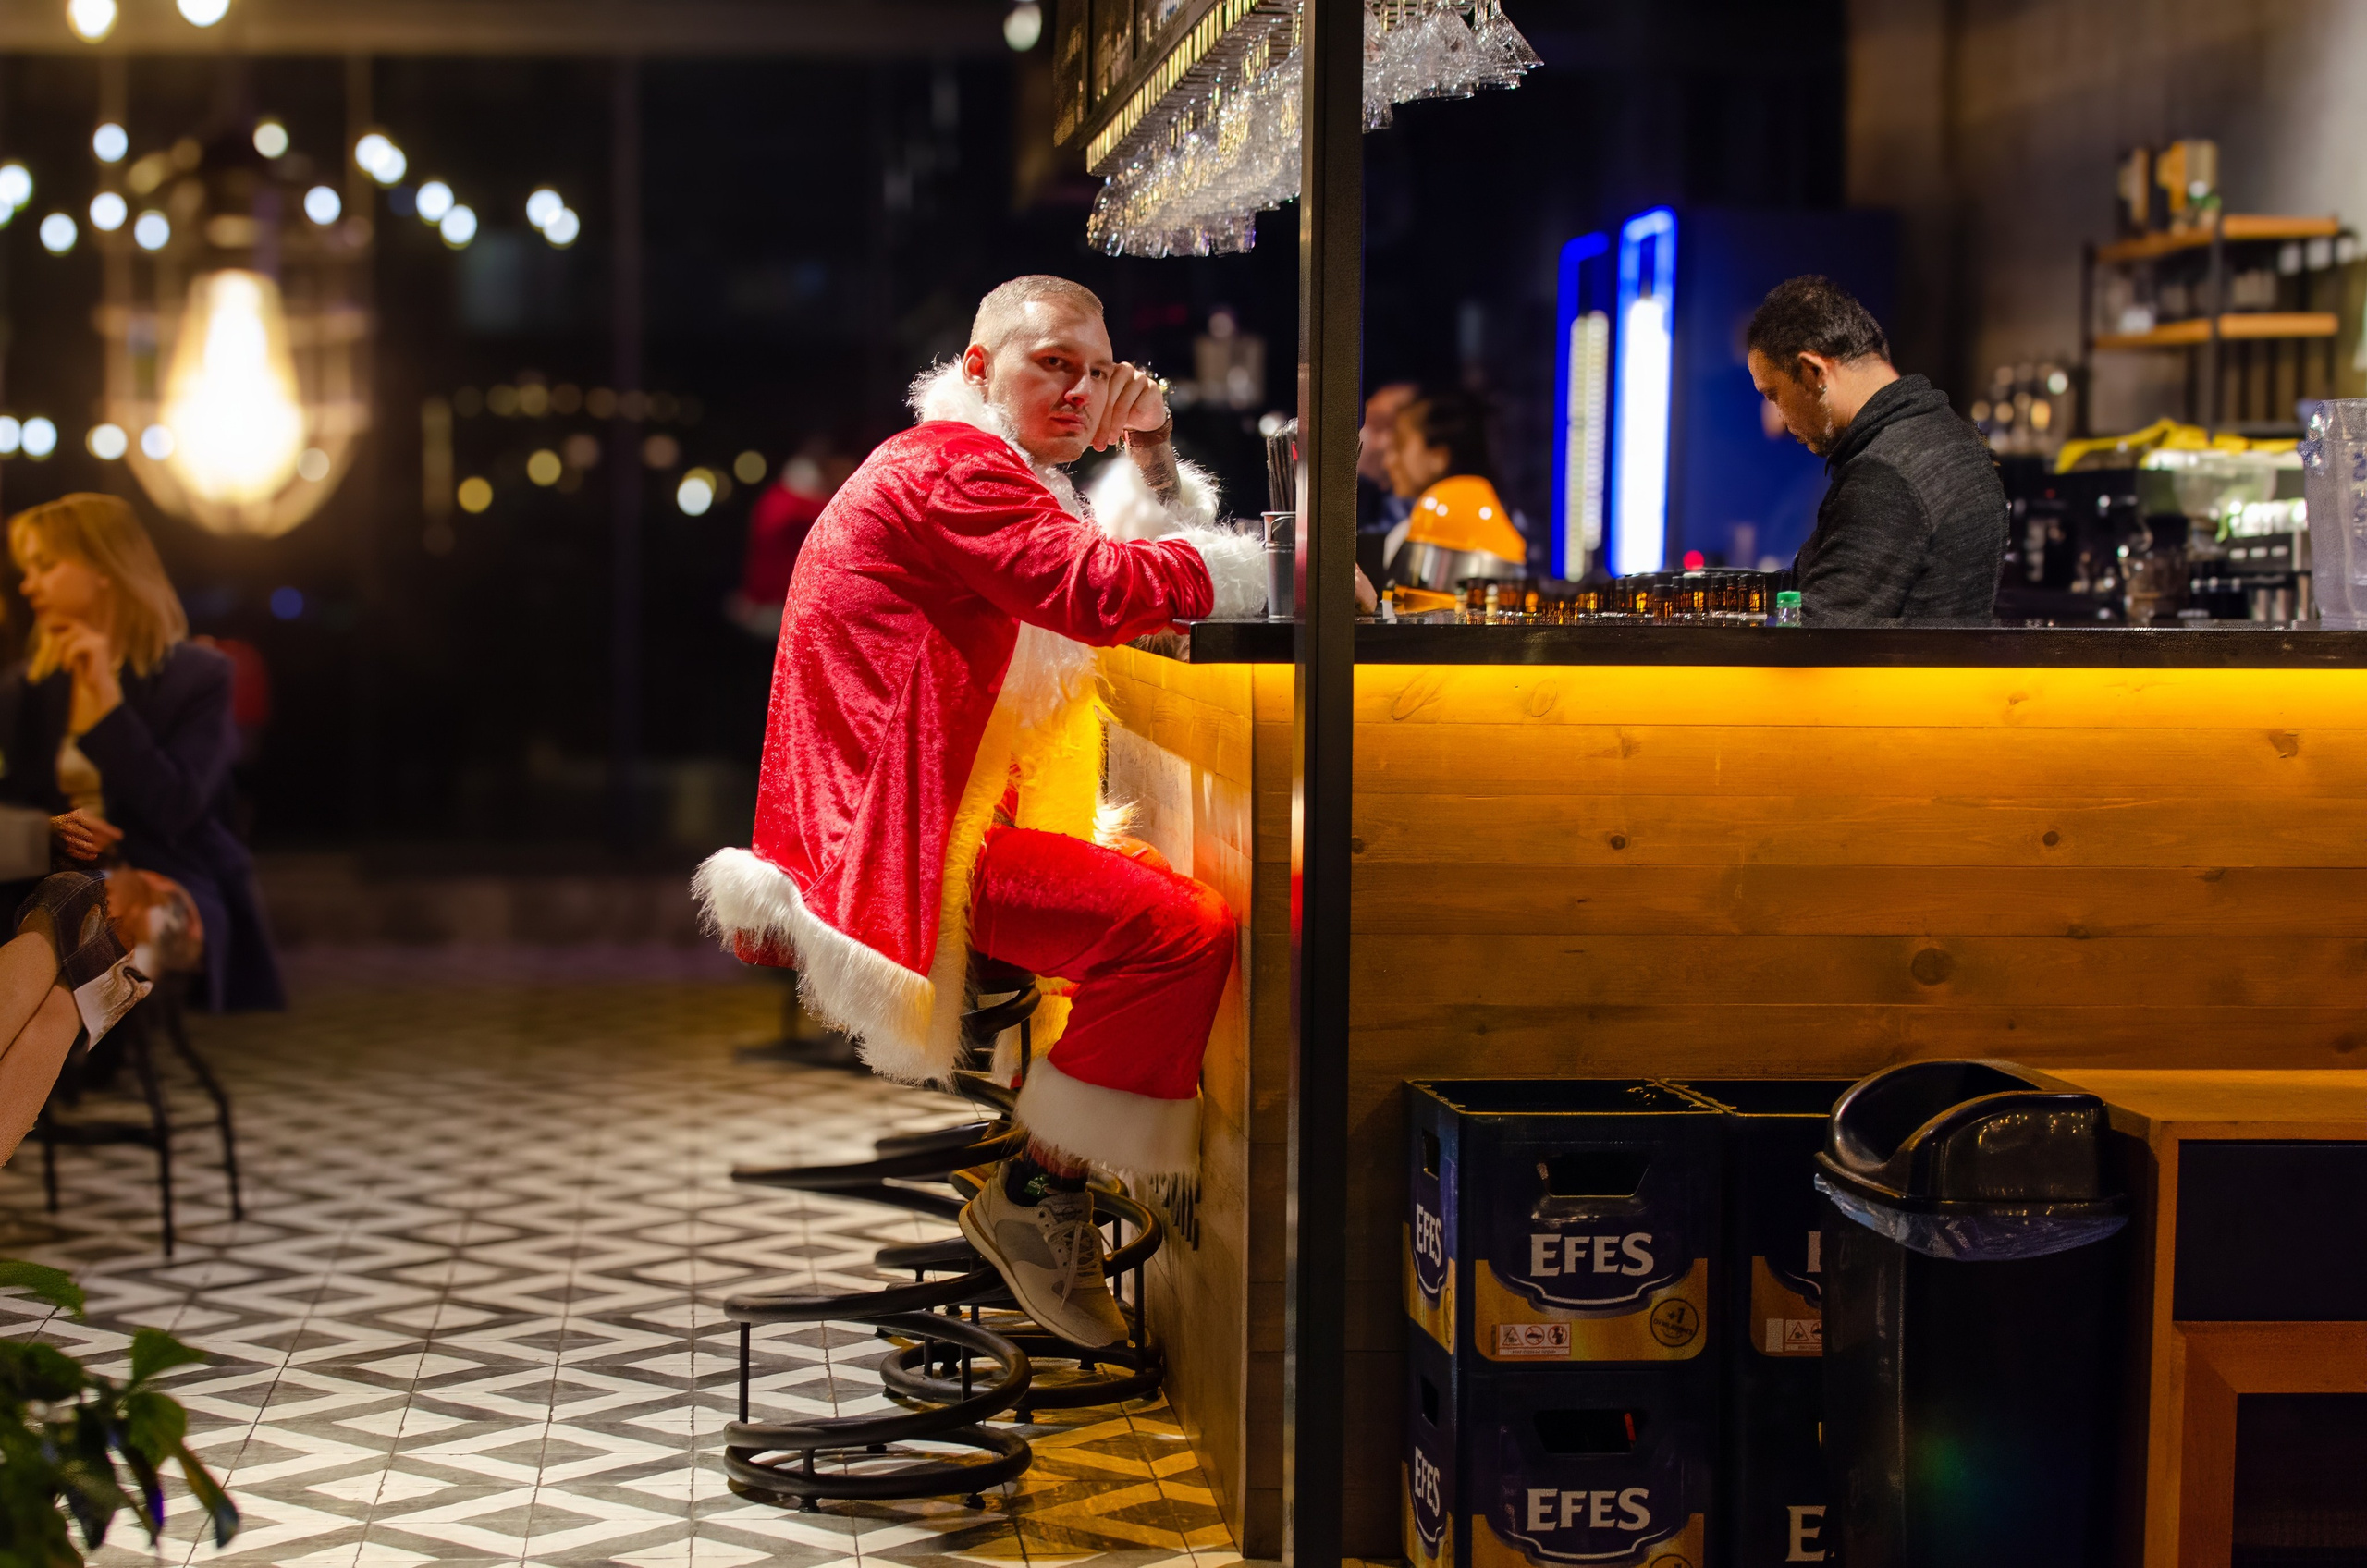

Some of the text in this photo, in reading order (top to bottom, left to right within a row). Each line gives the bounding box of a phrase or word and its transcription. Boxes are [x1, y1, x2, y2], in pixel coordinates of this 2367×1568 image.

[1417, 1203, 1441, 1268] EFES
[1529, 1232, 1655, 1278] EFES
[1415, 1446, 1441, 1518] EFES
[1527, 1487, 1650, 1532] EFES
